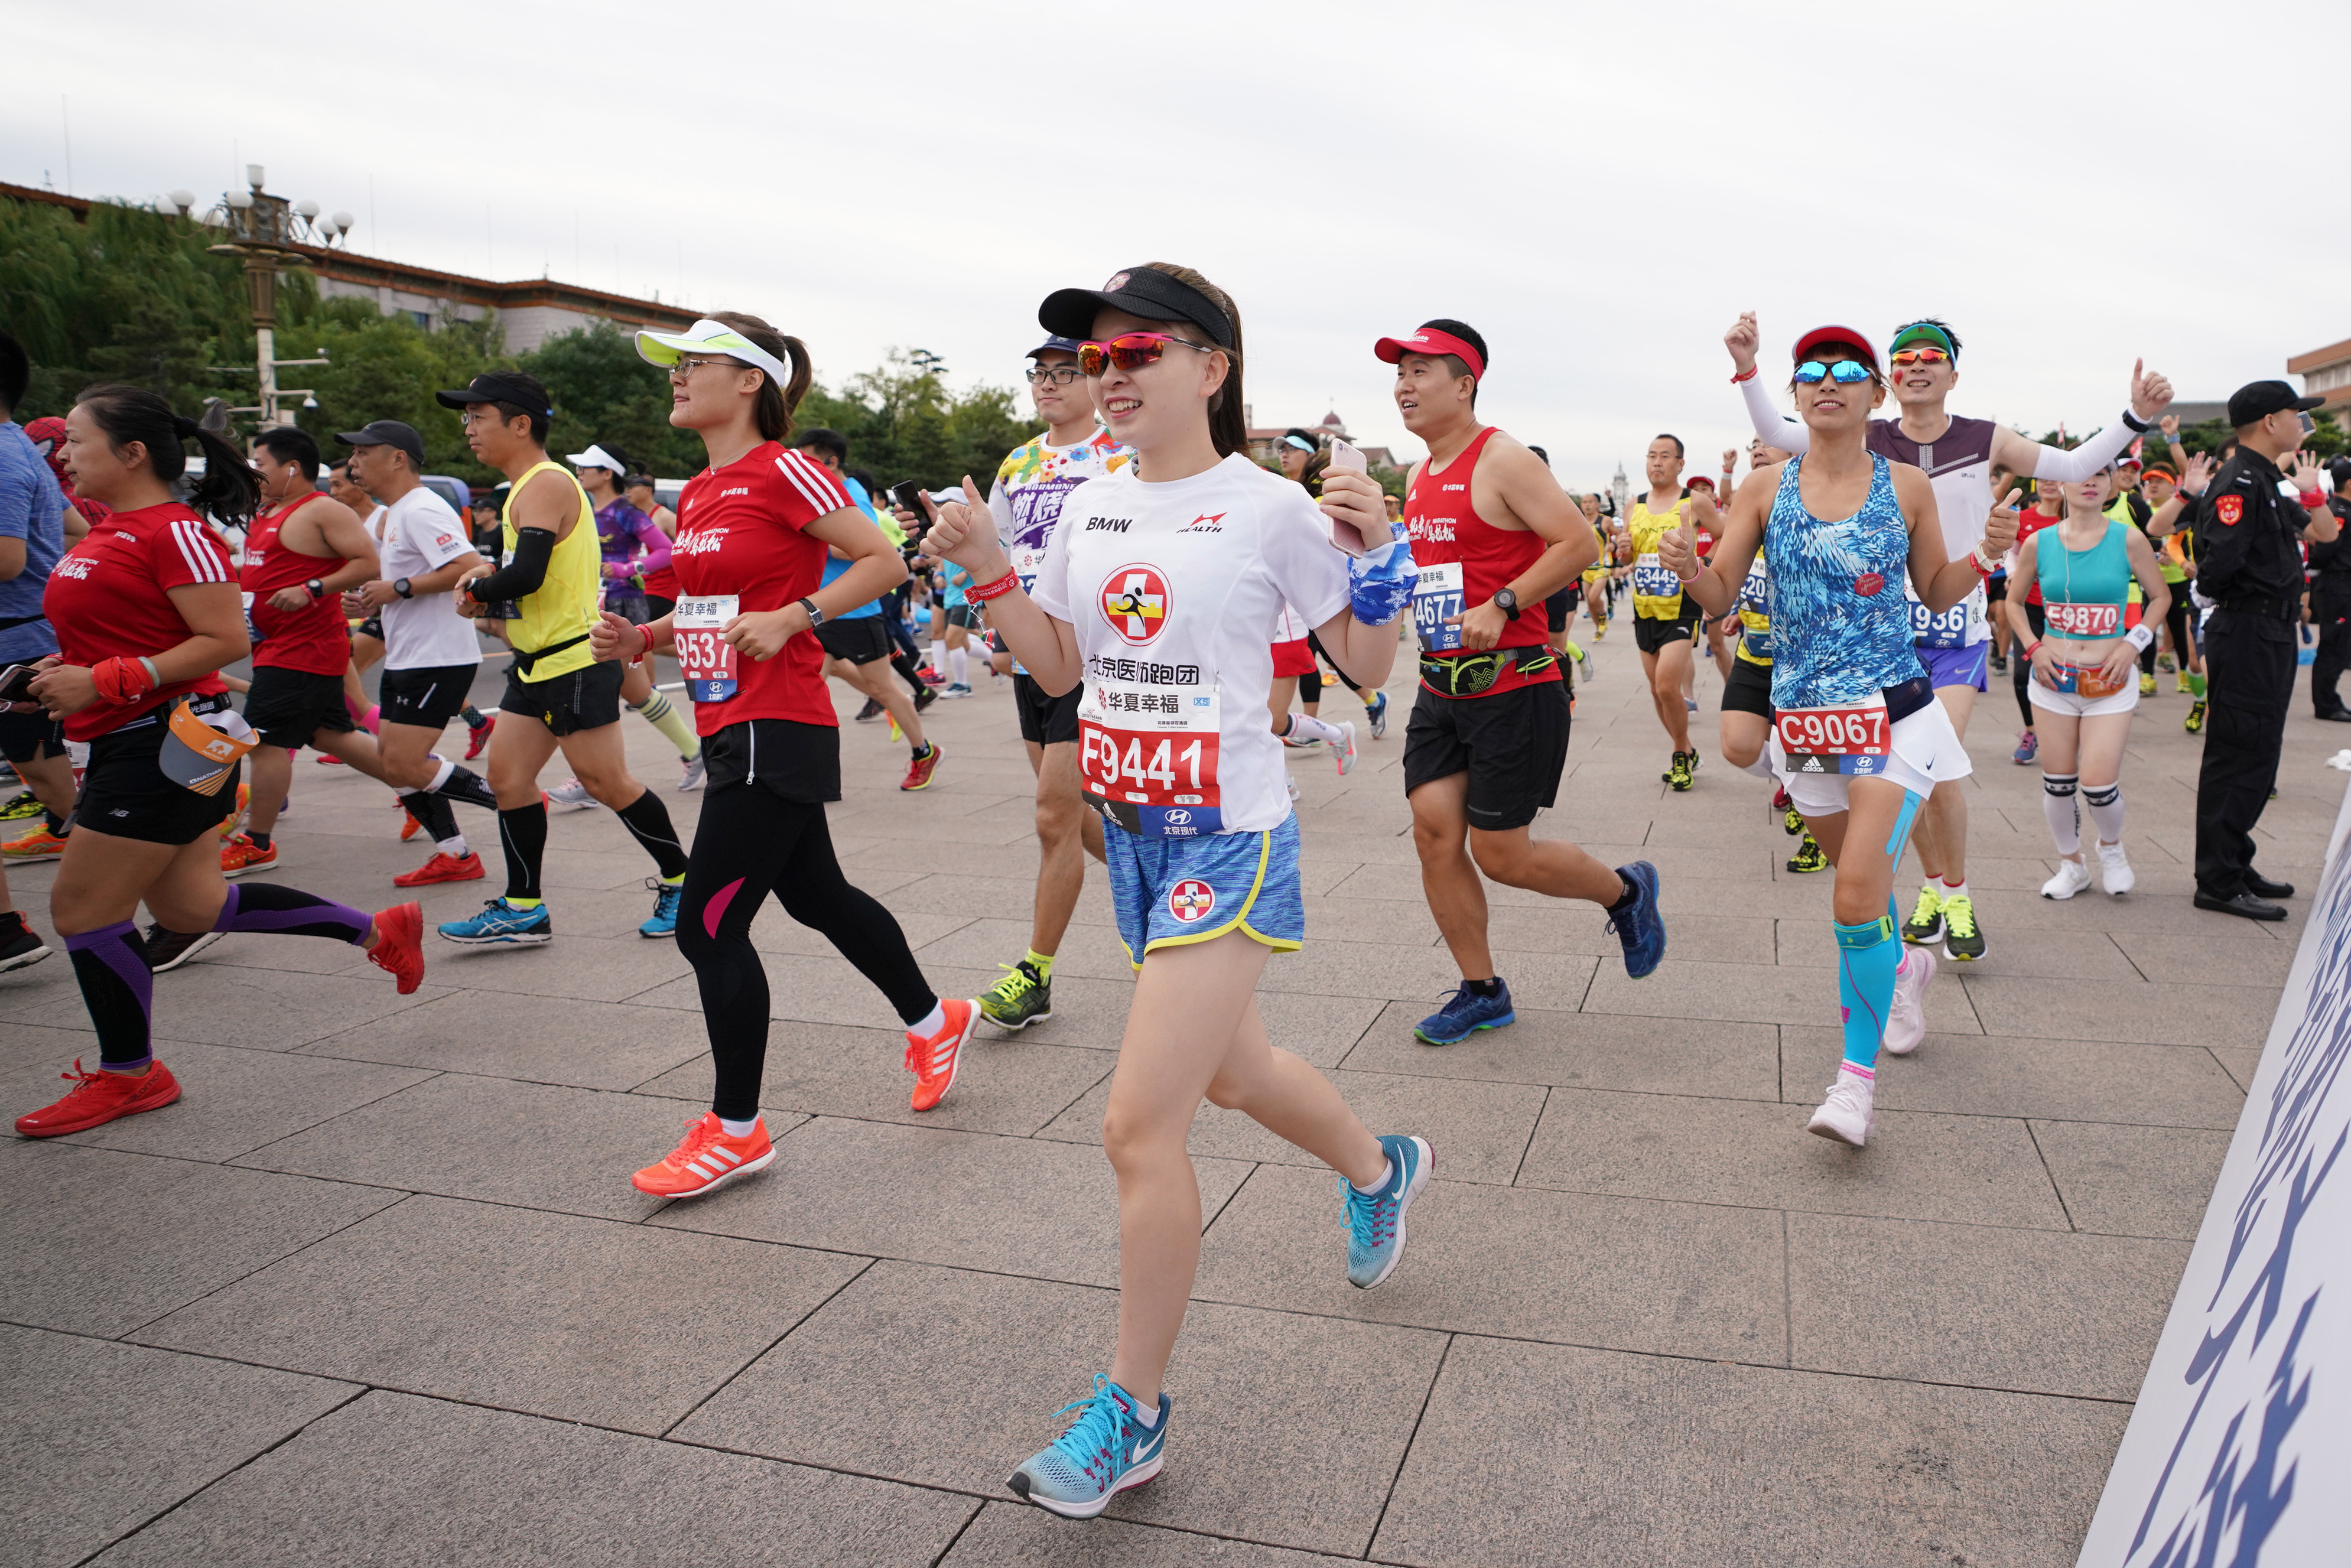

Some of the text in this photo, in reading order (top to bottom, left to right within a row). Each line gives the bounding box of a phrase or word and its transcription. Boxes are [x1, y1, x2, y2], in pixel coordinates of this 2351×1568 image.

[1012, 490, 1070, 529] 燃烧
[701, 528, 730, 536] MARATHON
[1085, 517, 1133, 533] BMW
[1634, 568, 1679, 584] C3445
[2047, 605, 2117, 629] E9870
[674, 632, 730, 669] 9537
[1088, 653, 1199, 685] 北京医师跑团
[1108, 692, 1179, 714] 华夏幸福
[1780, 711, 1885, 746] C9067
[1082, 727, 1203, 790] F9441
[196, 767, 223, 782] NATHAN
[1163, 826, 1199, 835] 北京现代
